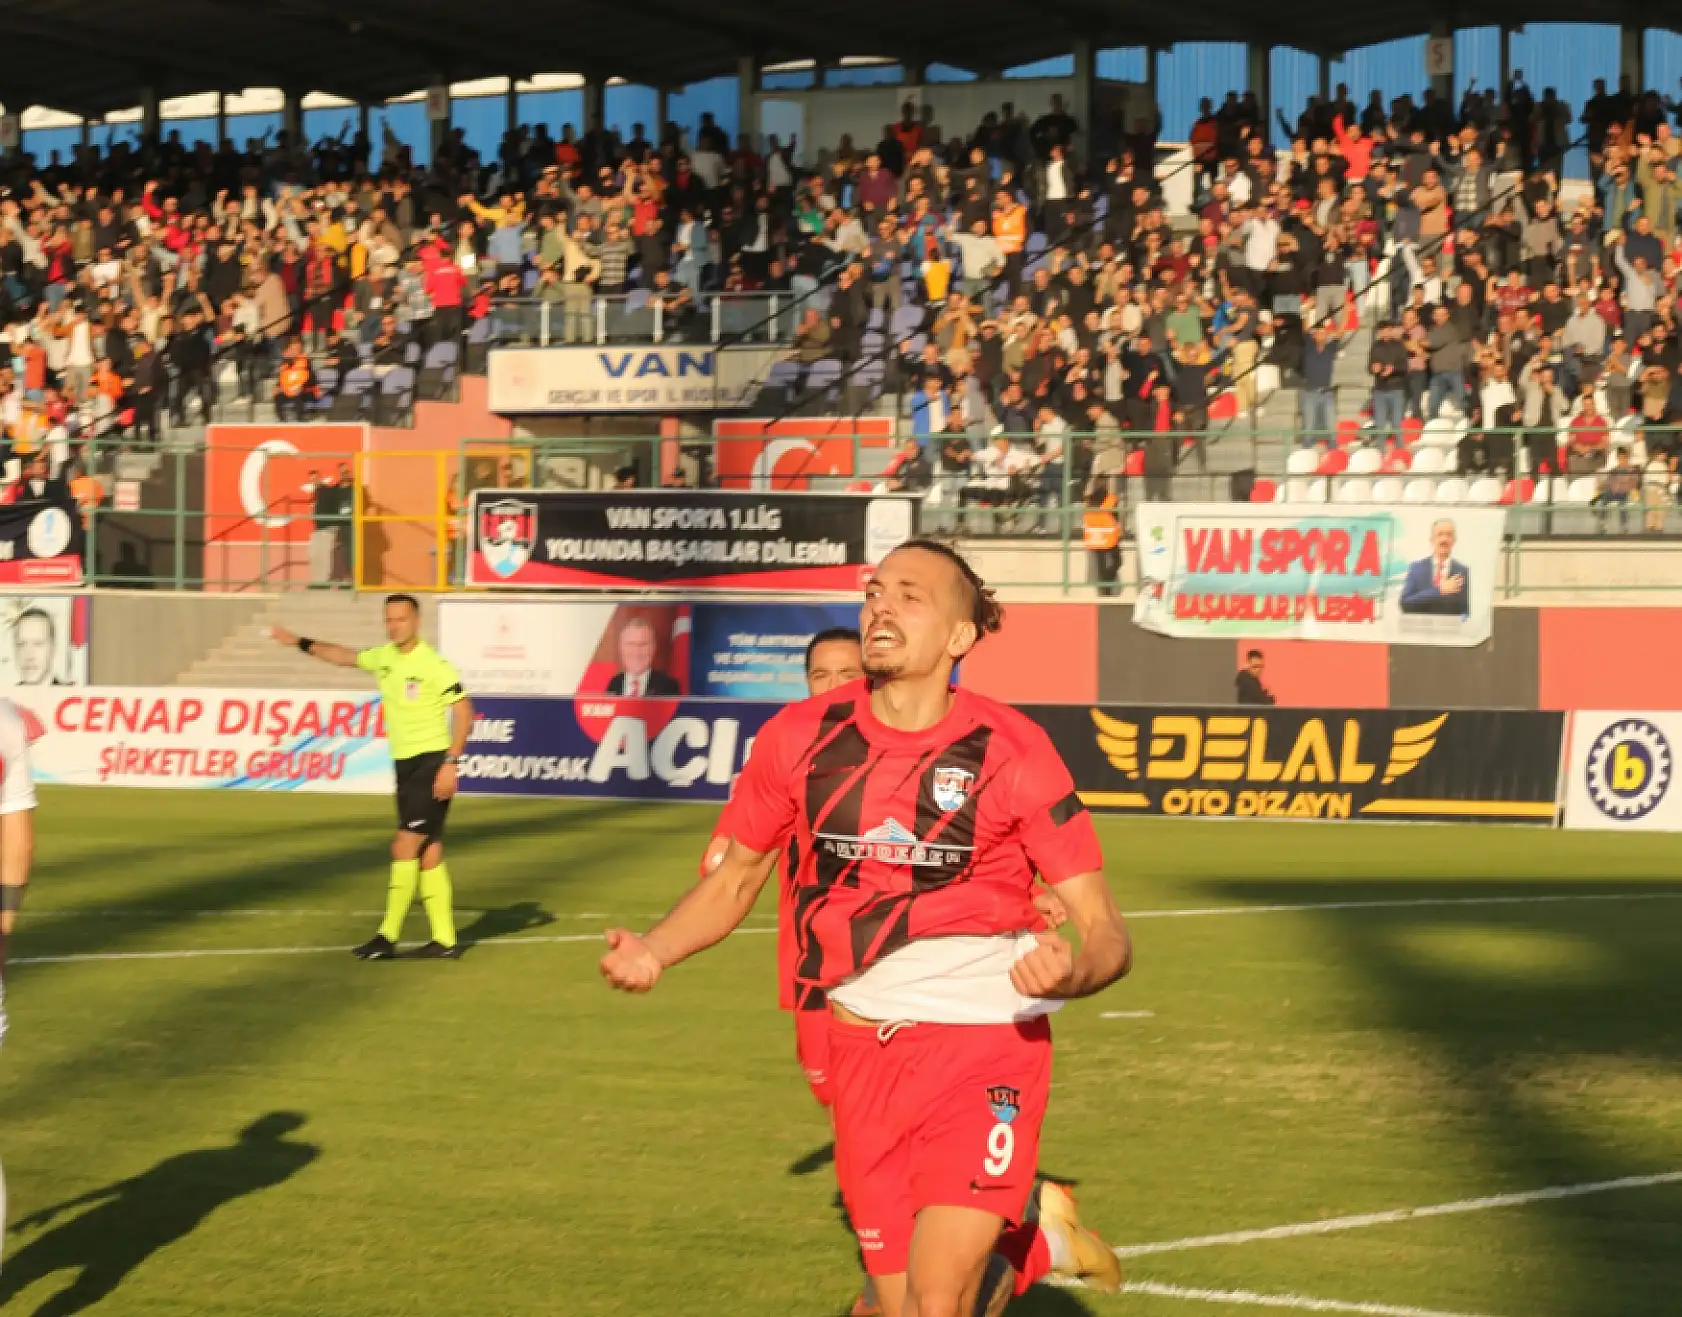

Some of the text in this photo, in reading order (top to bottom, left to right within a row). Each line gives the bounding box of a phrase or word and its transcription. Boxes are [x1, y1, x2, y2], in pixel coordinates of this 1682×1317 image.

[598, 352, 714, 378] VAN
[606, 507, 651, 529] VAN
[544, 536, 847, 567] YOLUNDA BAŞARILAR DİLERİM
[1183, 527, 1251, 574] VAN
[1174, 593, 1290, 623] BAŞARILAR
[54, 697, 204, 734] CENAP
[98, 743, 347, 781] ŞİRKETLER GRUBU
[1147, 715, 1375, 783] DELAL
[1161, 788, 1352, 819] OTO DİZAYN
[983, 1122, 1015, 1176] 9
